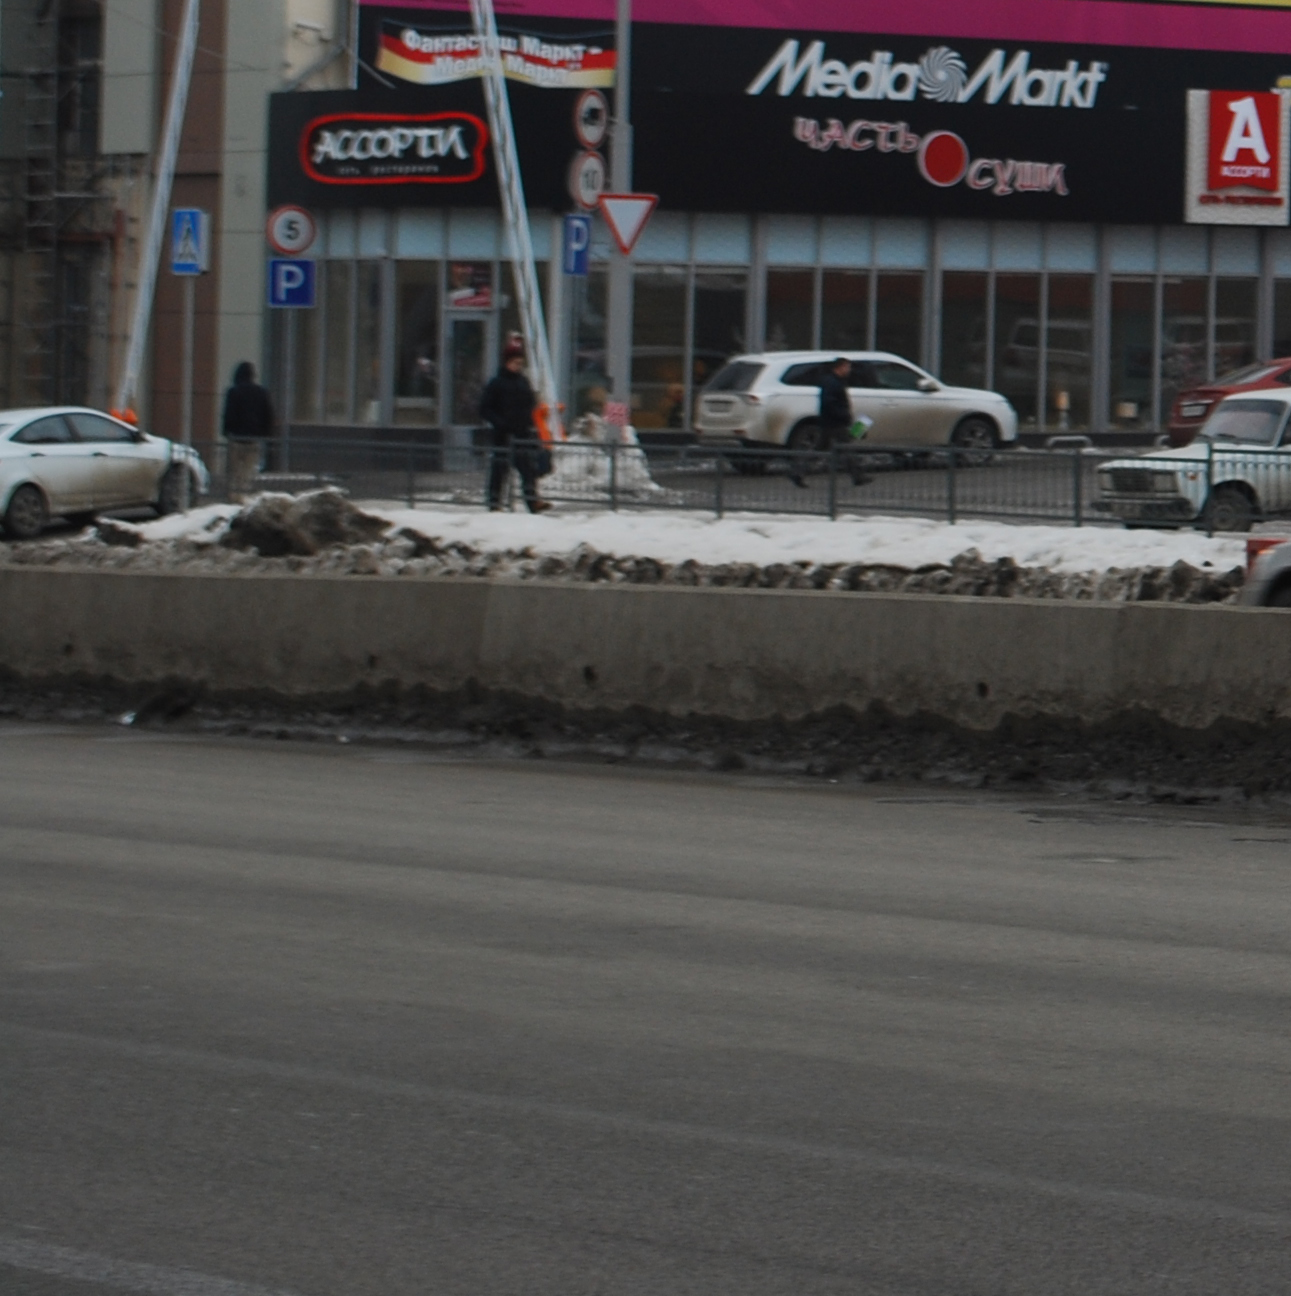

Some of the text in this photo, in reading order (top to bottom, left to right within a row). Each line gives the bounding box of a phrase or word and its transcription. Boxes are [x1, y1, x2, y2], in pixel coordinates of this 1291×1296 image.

[401, 28, 518, 55] Фантастш
[311, 125, 470, 164] АССОРТИ
[966, 158, 1070, 195] СУШИ
[285, 220, 300, 241] 5
[569, 218, 588, 273] P
[277, 264, 305, 301] P
